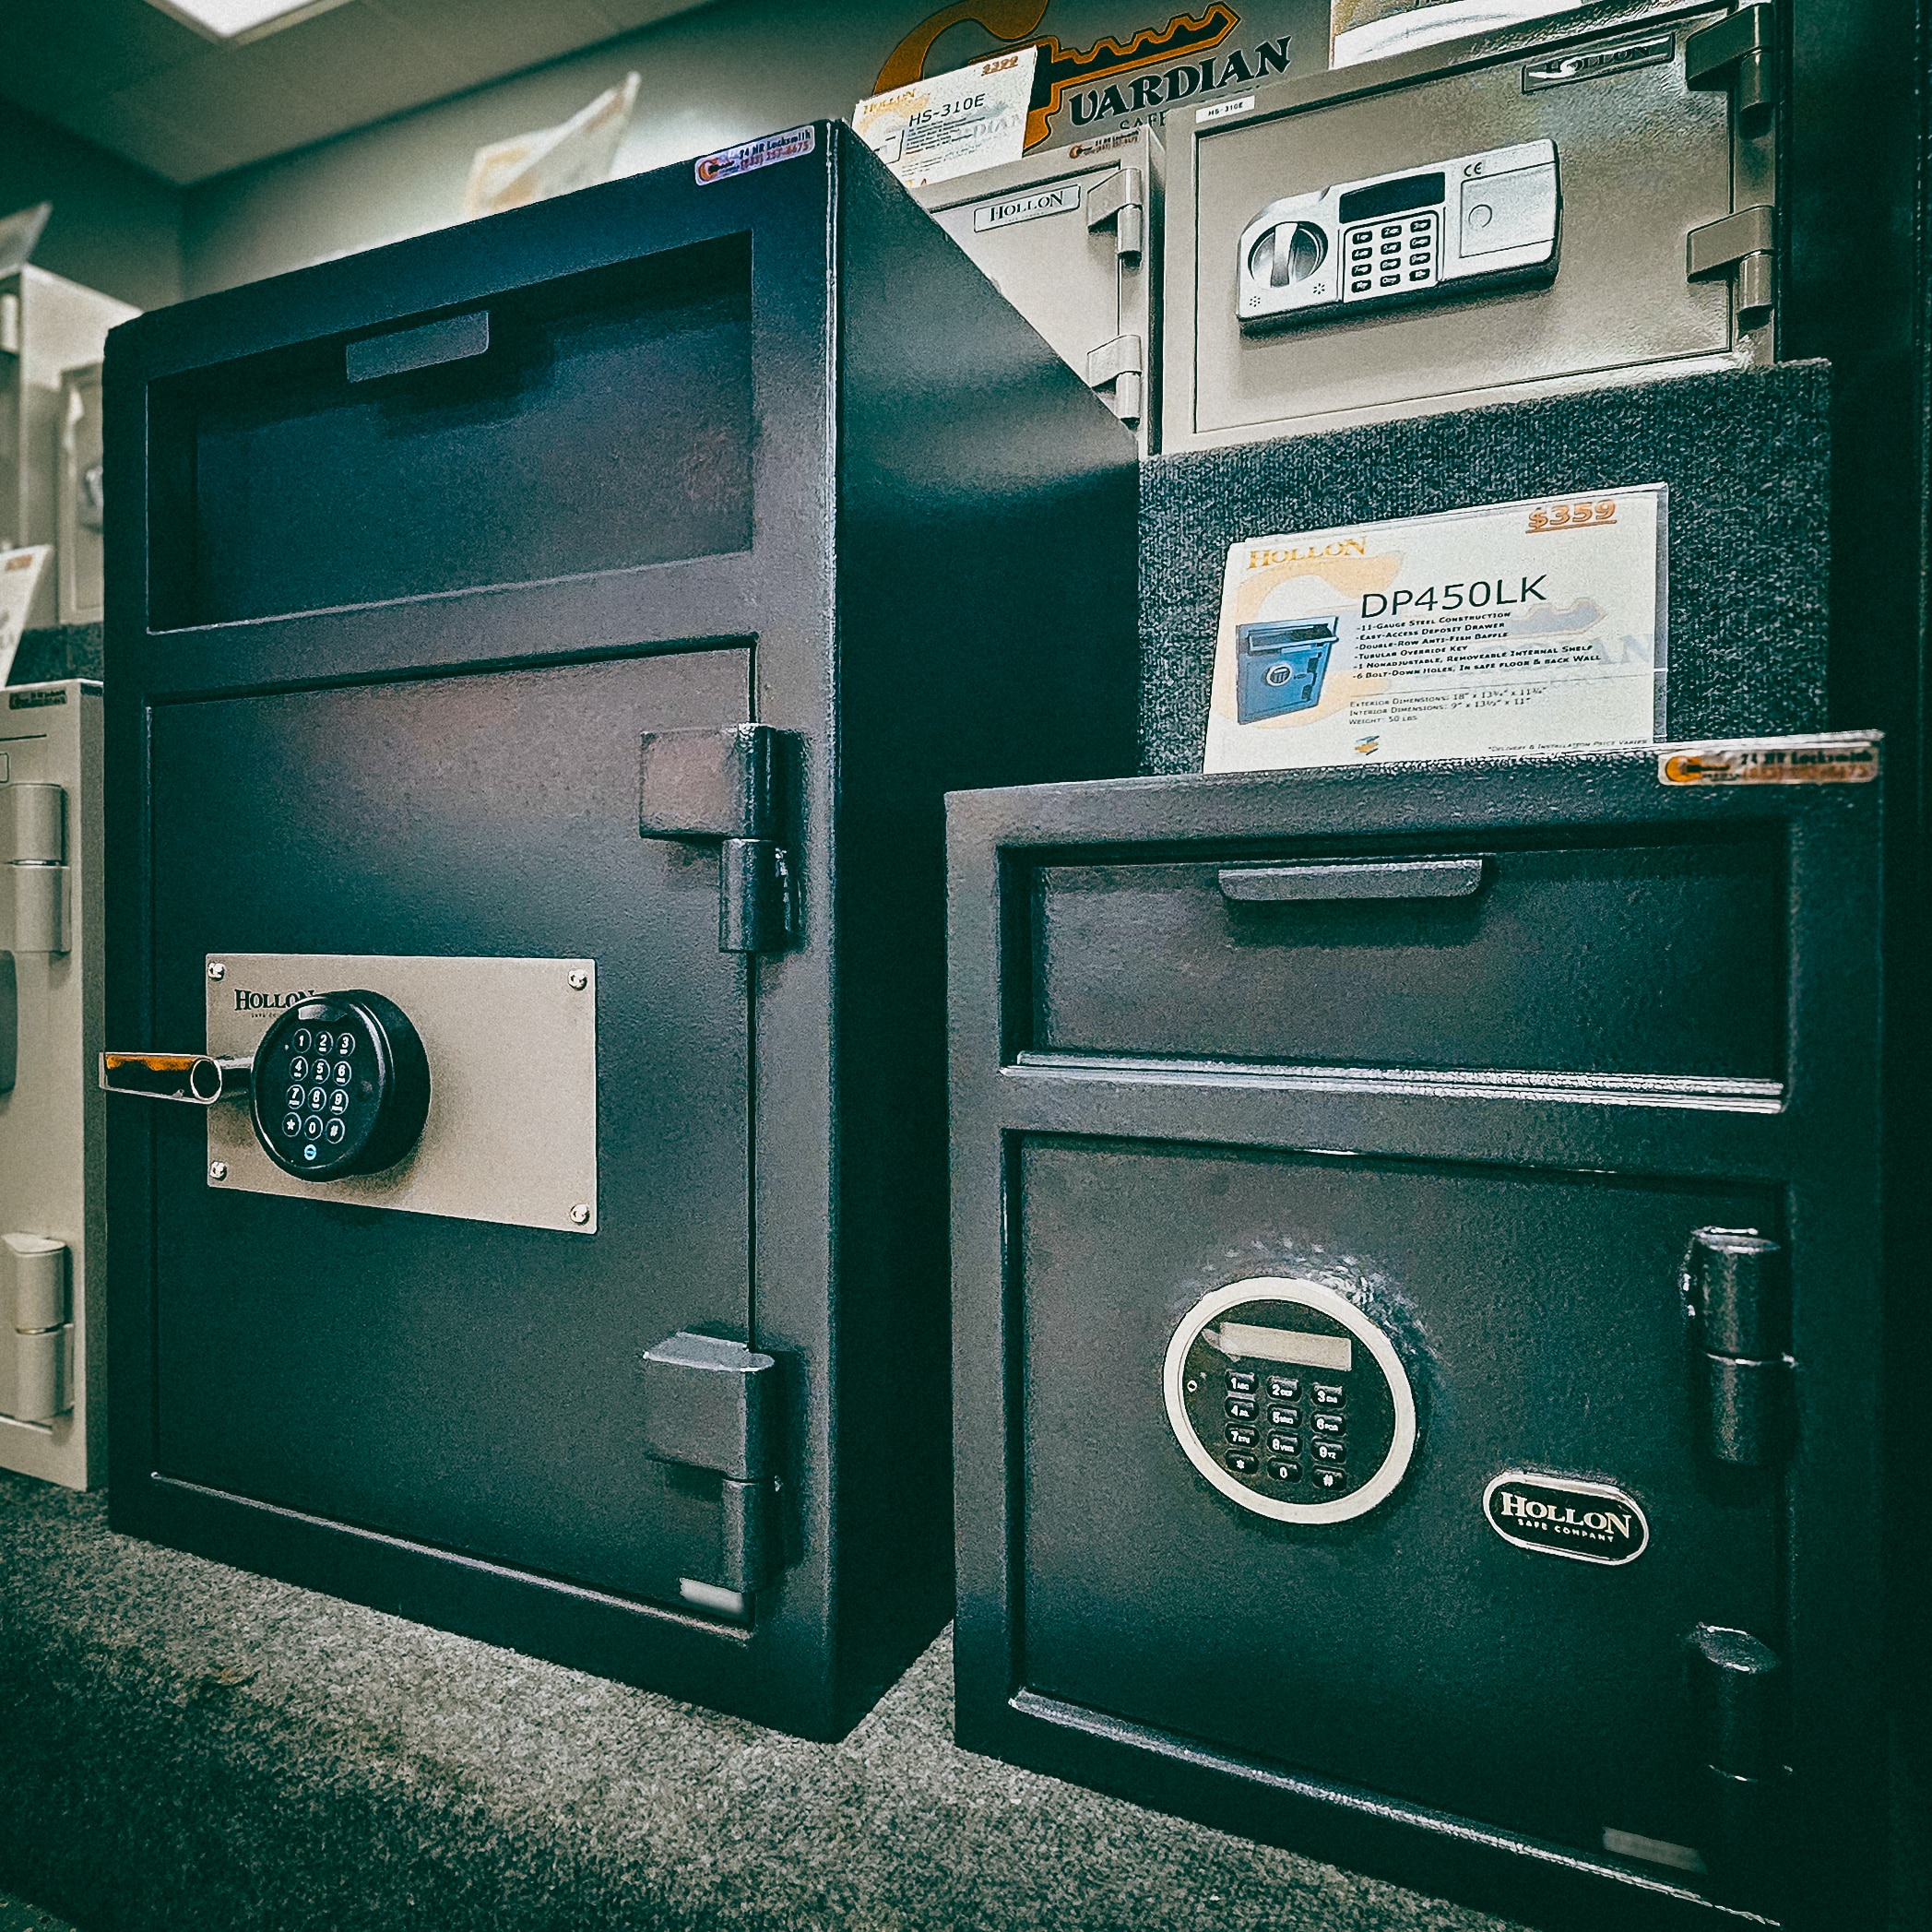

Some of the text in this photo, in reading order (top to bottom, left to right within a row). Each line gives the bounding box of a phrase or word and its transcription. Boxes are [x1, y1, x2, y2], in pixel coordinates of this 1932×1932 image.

[908, 92, 986, 127] HS-310E
[1464, 161, 1483, 177] CE
[990, 190, 1063, 222] HOLLON
[1528, 499, 1616, 531] $359
[1247, 536, 1367, 570] HOLLON
[1361, 574, 1547, 619] DP450LK
[1439, 612, 1511, 623] CONSTRUCTION
[299, 1034, 350, 1049] 1 2 3
[295, 1060, 346, 1077] 4 5 6
[292, 1087, 342, 1106] 7 8 9
[308, 1121, 316, 1134] 0
[1279, 1466, 1288, 1478] 0
[1500, 1491, 1631, 1539] HOLLON
[1518, 1518, 1615, 1542] SAFE COMPANY
